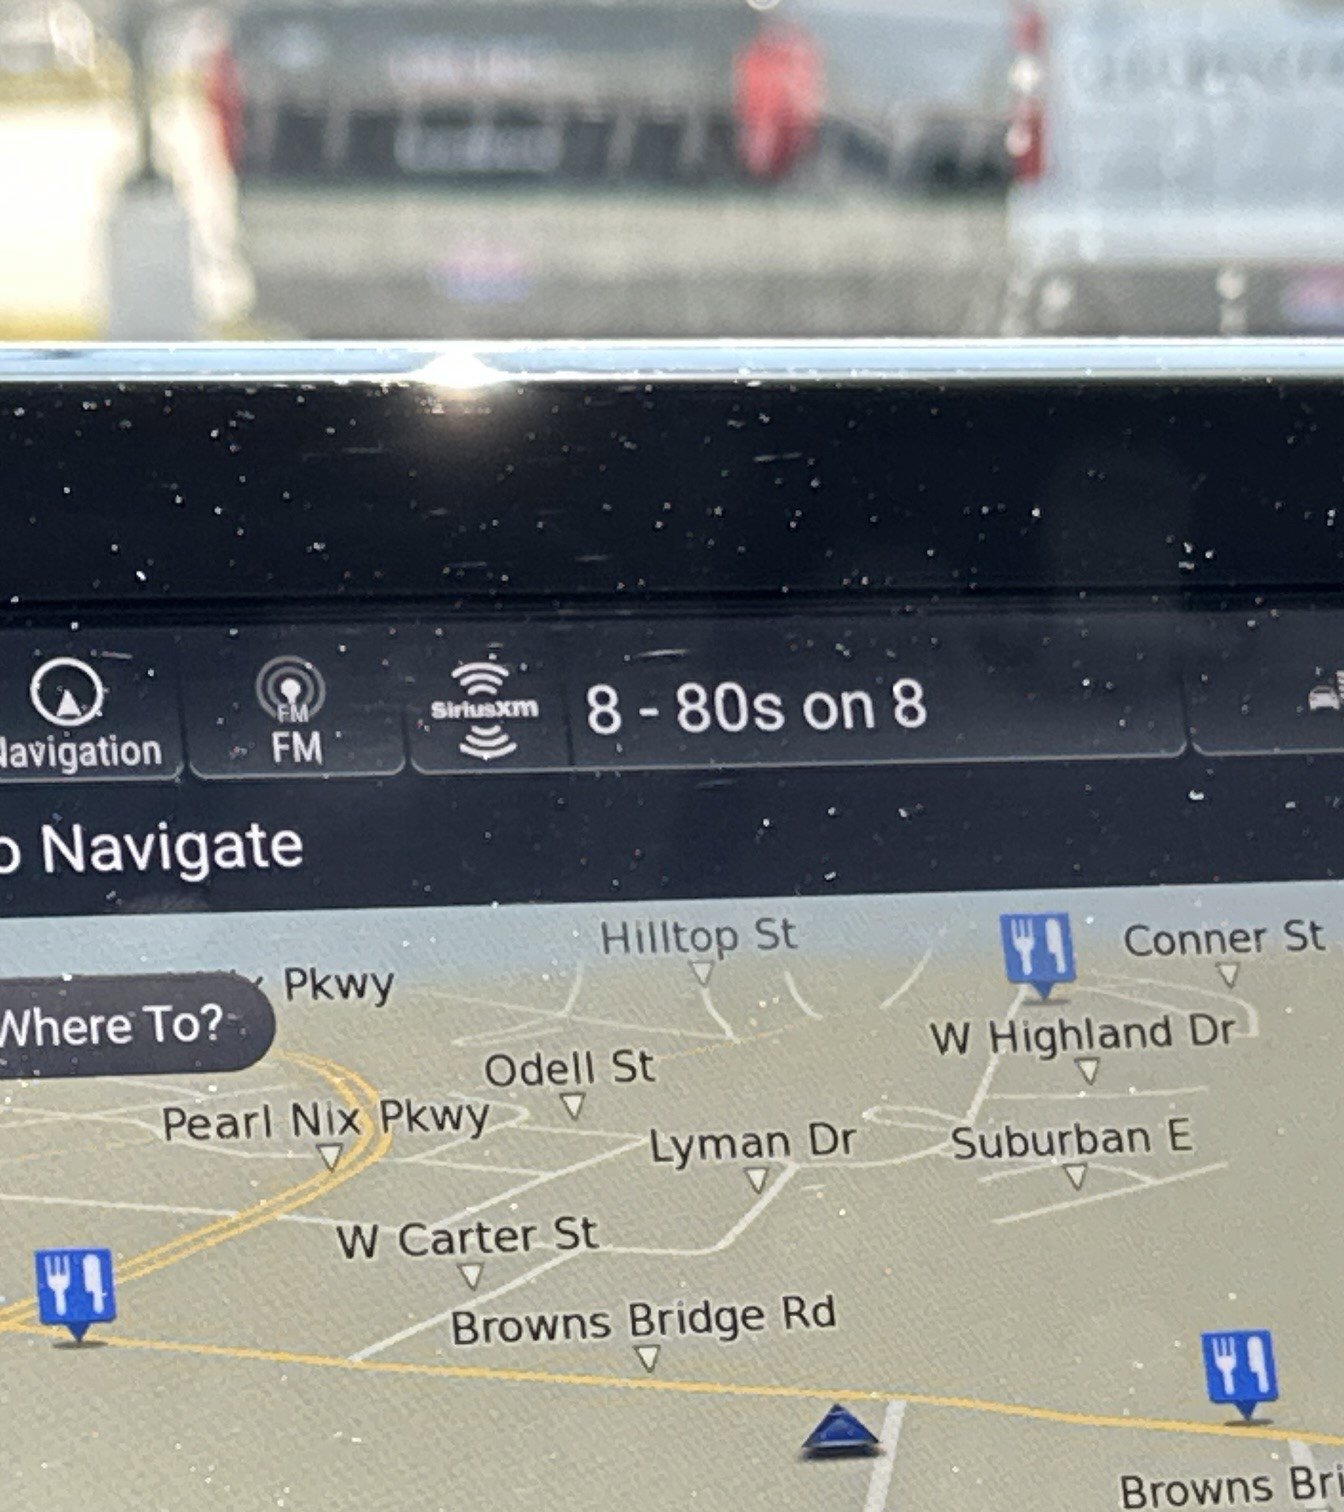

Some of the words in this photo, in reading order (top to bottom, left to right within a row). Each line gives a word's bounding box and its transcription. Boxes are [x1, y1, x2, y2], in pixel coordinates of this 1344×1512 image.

[586, 685, 622, 734] 8
[676, 681, 785, 733] 80s
[803, 692, 875, 730] on
[892, 678, 928, 727] 8
[271, 730, 324, 765] FM
[41, 823, 304, 882] Navigate
[601, 921, 739, 957] Hilltop
[754, 919, 799, 950] St
[1124, 923, 1267, 957] Conner
[1283, 920, 1326, 953] St
[284, 966, 395, 1008] Pkwy
[141, 1003, 223, 1045] To?
[930, 1021, 972, 1056] W
[989, 1014, 1174, 1060] Highland
[1189, 1015, 1238, 1046] Dr
[484, 1051, 597, 1088] Odell
[612, 1047, 657, 1083] St
[162, 1105, 274, 1141] Pearl
[291, 1102, 362, 1137] Nix
[379, 1098, 491, 1141] Pkwy
[951, 1120, 1153, 1160] Suburban
[1167, 1118, 1193, 1151] E
[650, 1125, 793, 1166] Lyman
[809, 1123, 857, 1155] Dr
[336, 1224, 378, 1260] W
[398, 1222, 537, 1256] Carter
[554, 1216, 599, 1250] St
[452, 1308, 612, 1345] Browns
[629, 1301, 766, 1341] Bridge
[783, 1295, 837, 1330] Rd
[1121, 1476, 1274, 1510] Browns
